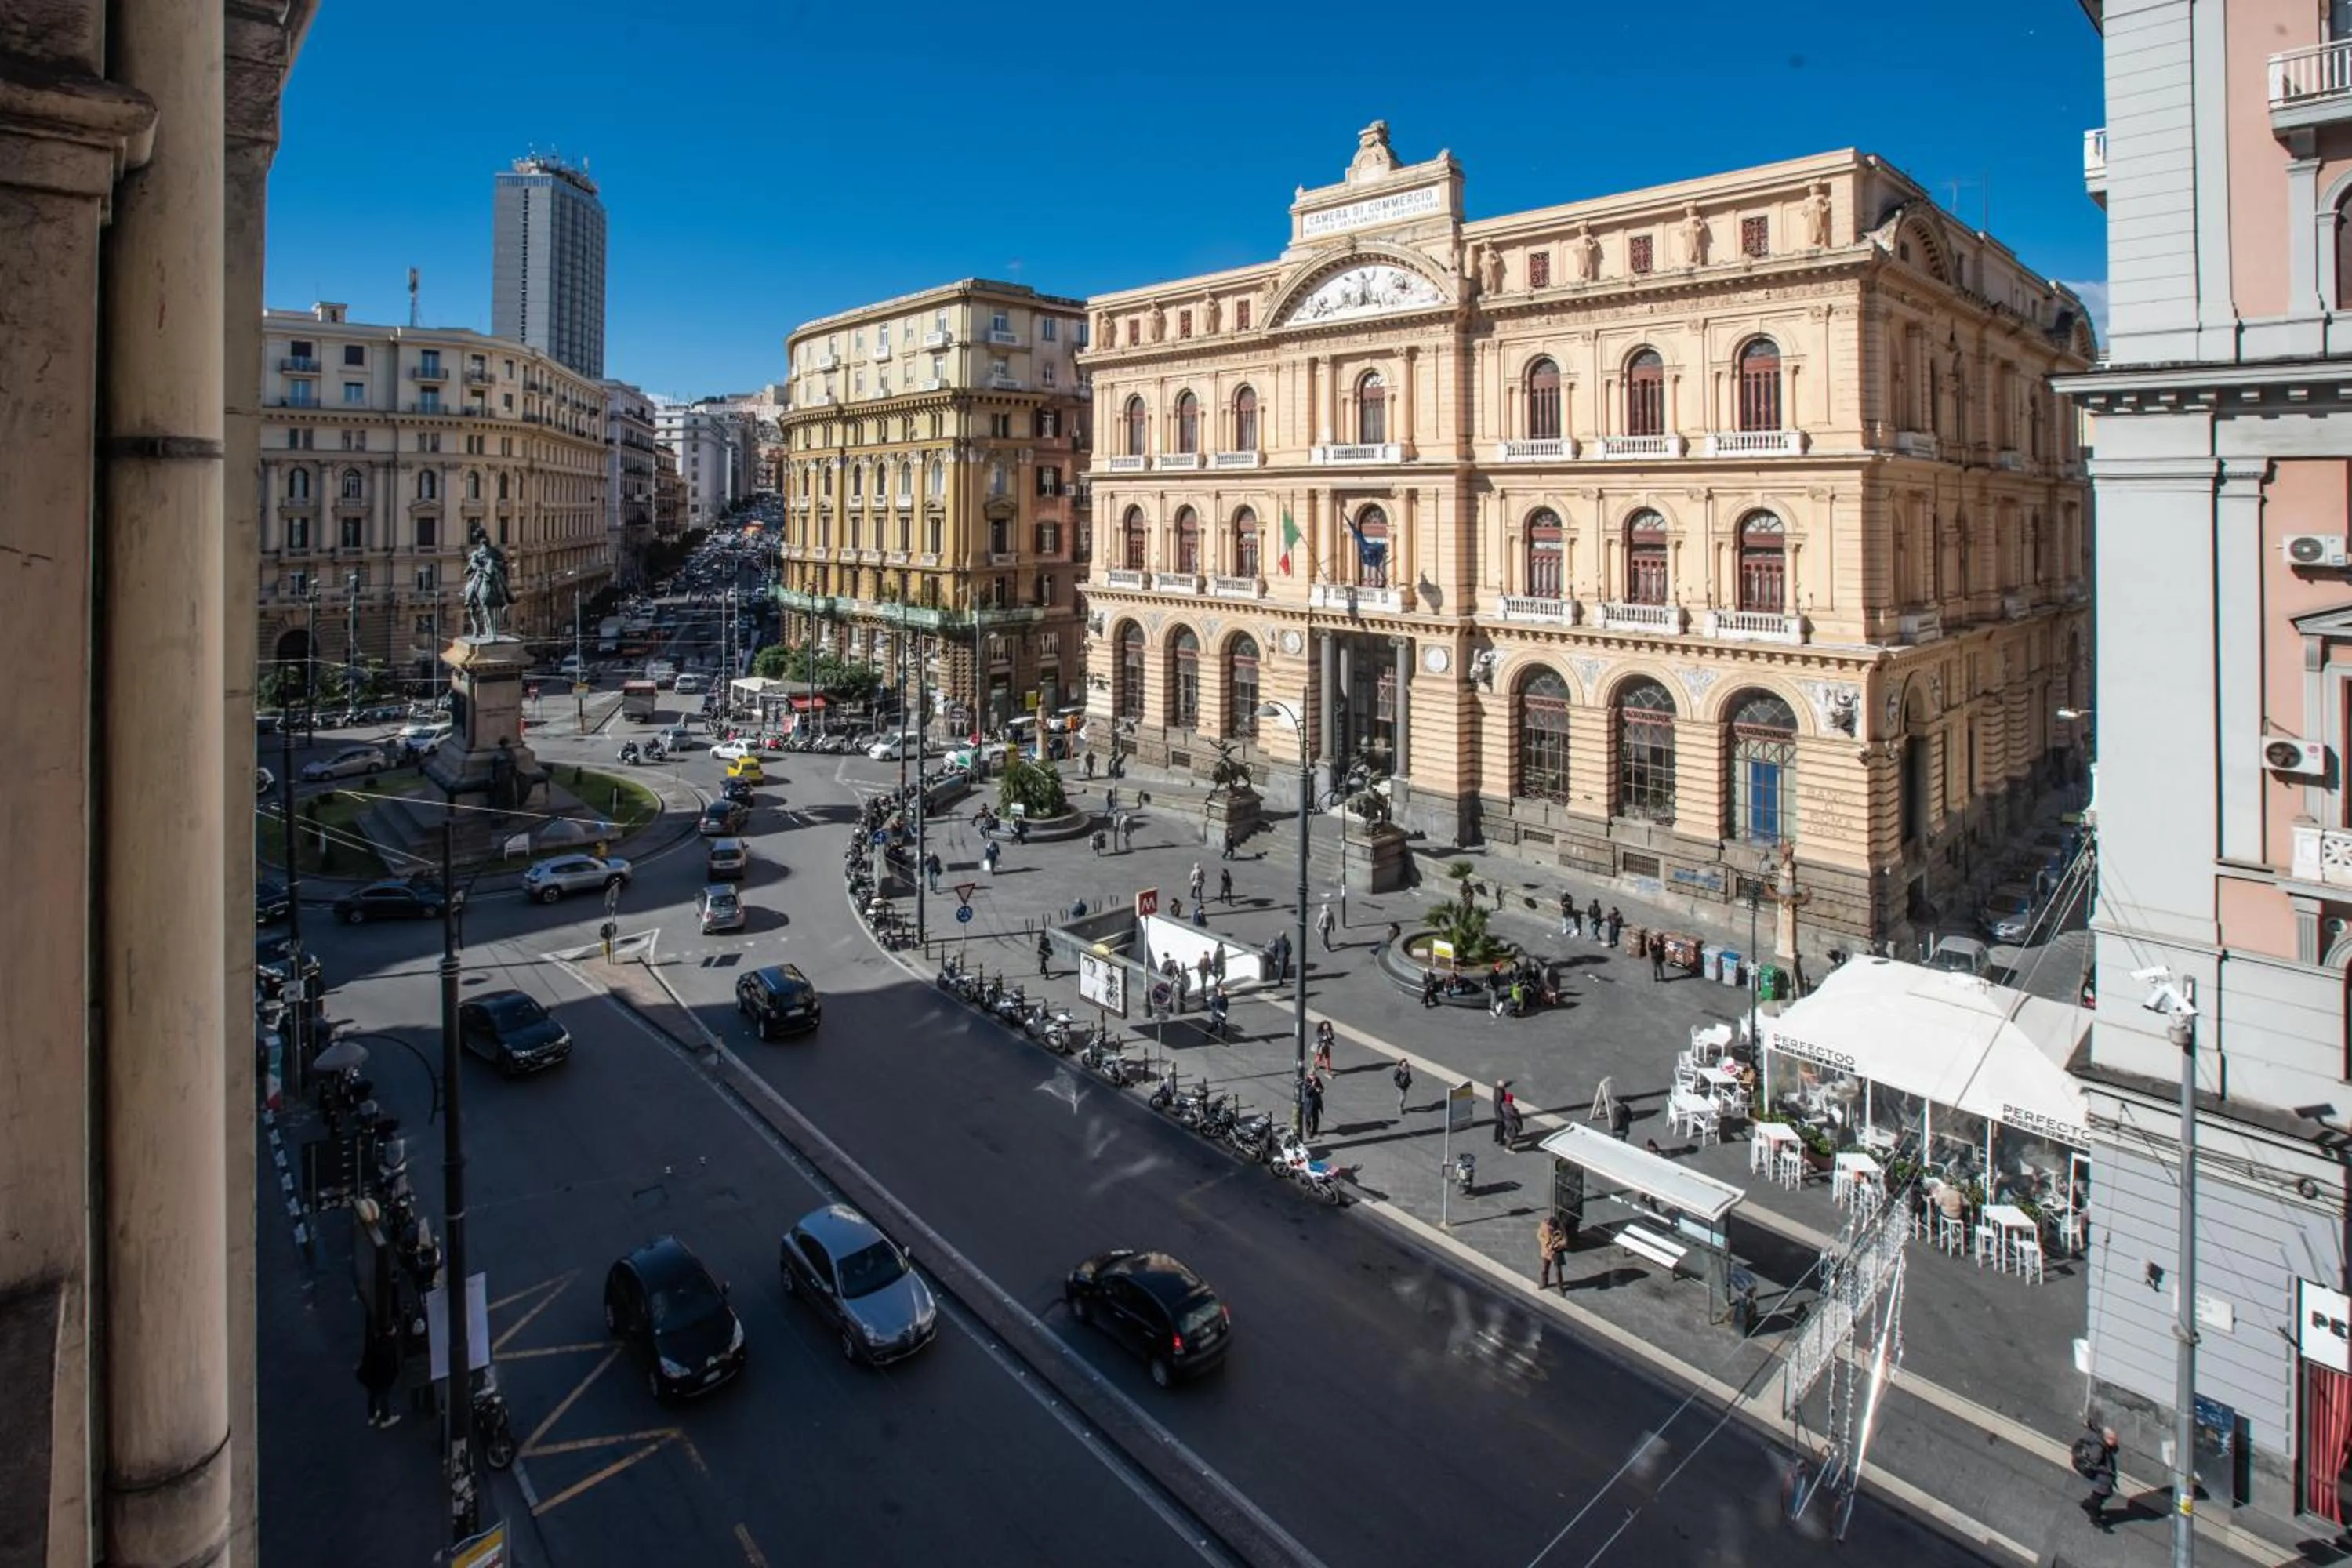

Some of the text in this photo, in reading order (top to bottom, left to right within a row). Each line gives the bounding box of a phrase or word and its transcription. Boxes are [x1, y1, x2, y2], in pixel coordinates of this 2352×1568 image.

[1308, 189, 1433, 226] CAMERA DI COMMERCIO
[1141, 896, 1156, 912] M
[1773, 1033, 1855, 1065] PERFECTOO
